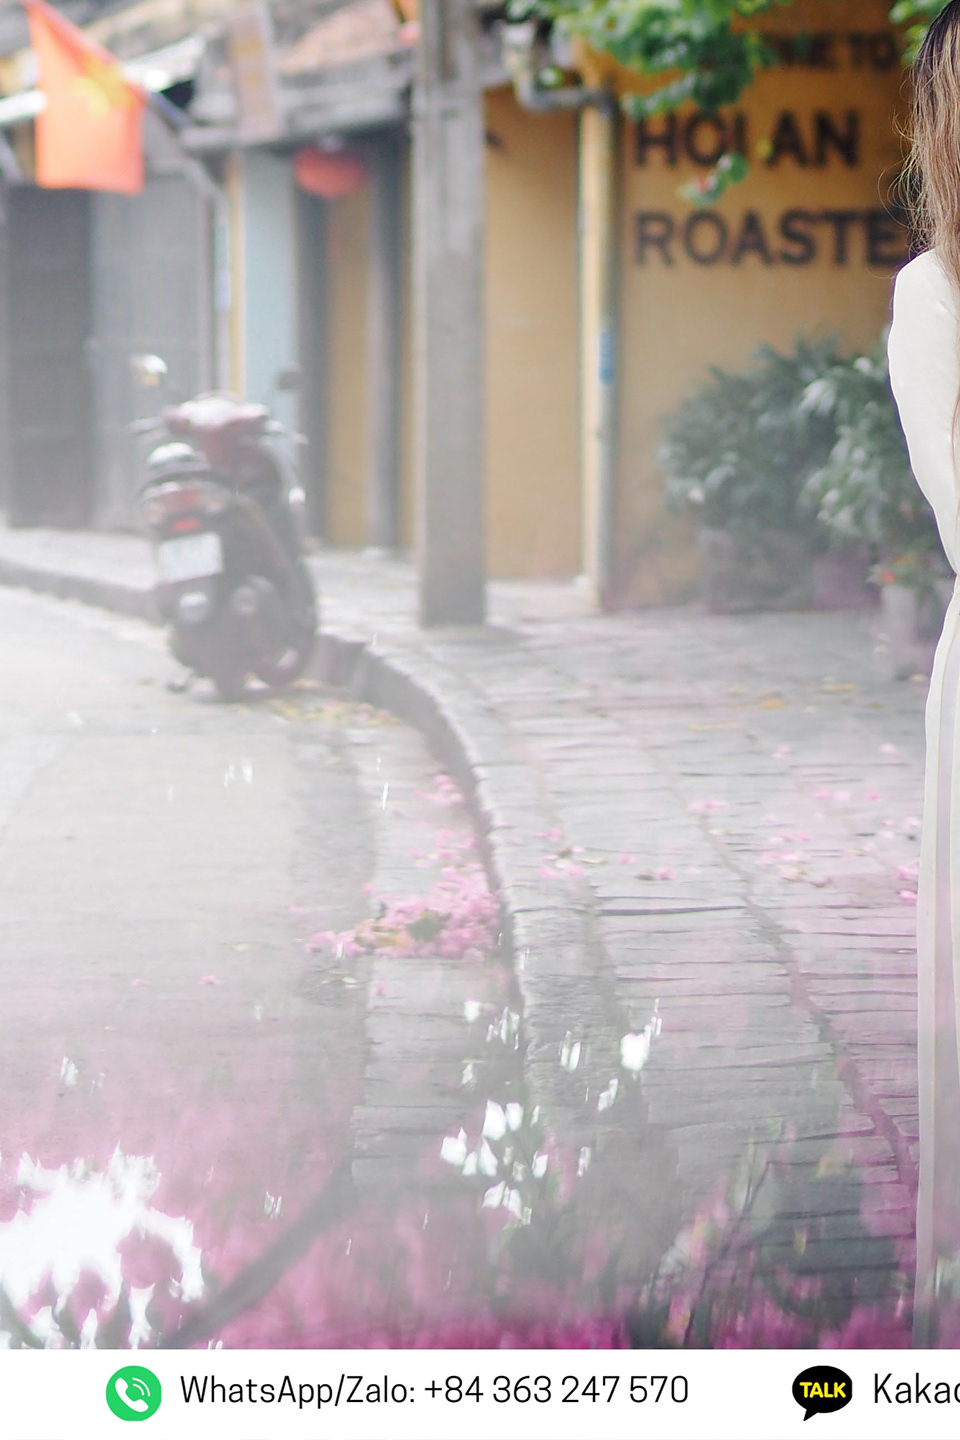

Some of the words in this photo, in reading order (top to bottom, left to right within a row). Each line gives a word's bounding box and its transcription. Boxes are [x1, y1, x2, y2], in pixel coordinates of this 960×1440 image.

[848, 31, 905, 71] TO
[634, 109, 747, 167] HOI
[767, 108, 860, 168] AN
[634, 209, 905, 268] ROASTE
